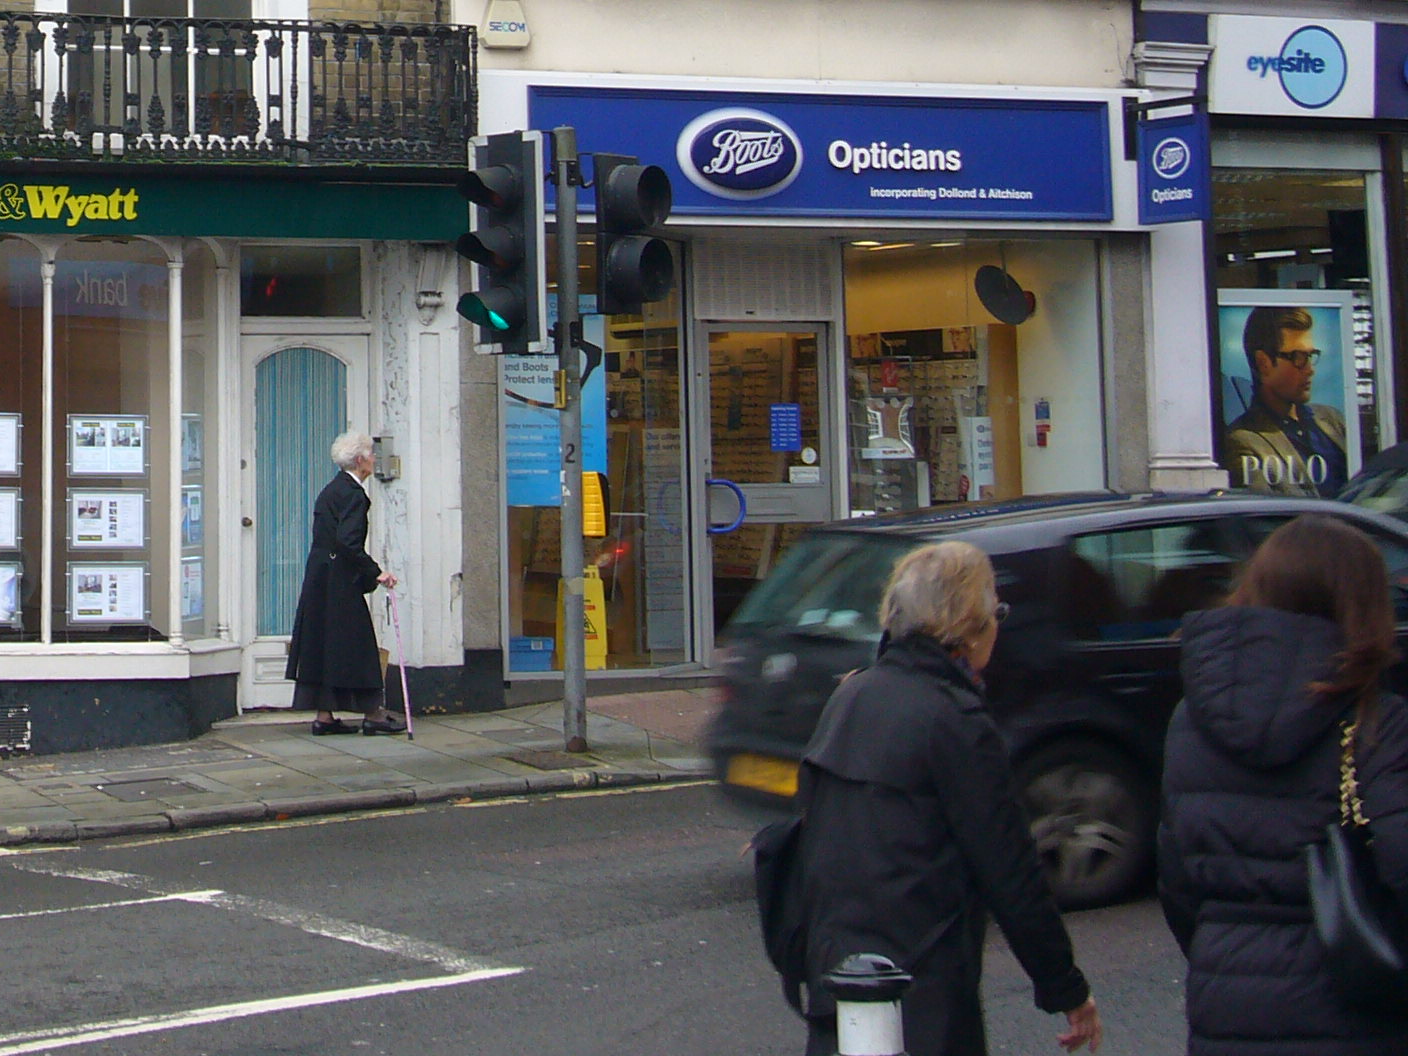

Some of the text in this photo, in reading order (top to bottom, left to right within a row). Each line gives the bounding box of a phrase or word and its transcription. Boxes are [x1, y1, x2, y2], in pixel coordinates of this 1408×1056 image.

[489, 20, 526, 33] SECOM
[1246, 48, 1326, 78] eyesite
[703, 129, 785, 175] Boots
[828, 139, 962, 174] Opticians
[939, 187, 977, 199] Dollond
[979, 189, 987, 199] &
[988, 188, 1033, 200] Aitchison
[1152, 187, 1193, 204] Opticians
[522, 362, 549, 372] Boots
[564, 443, 576, 464] 2
[1241, 454, 1327, 486] POLO
